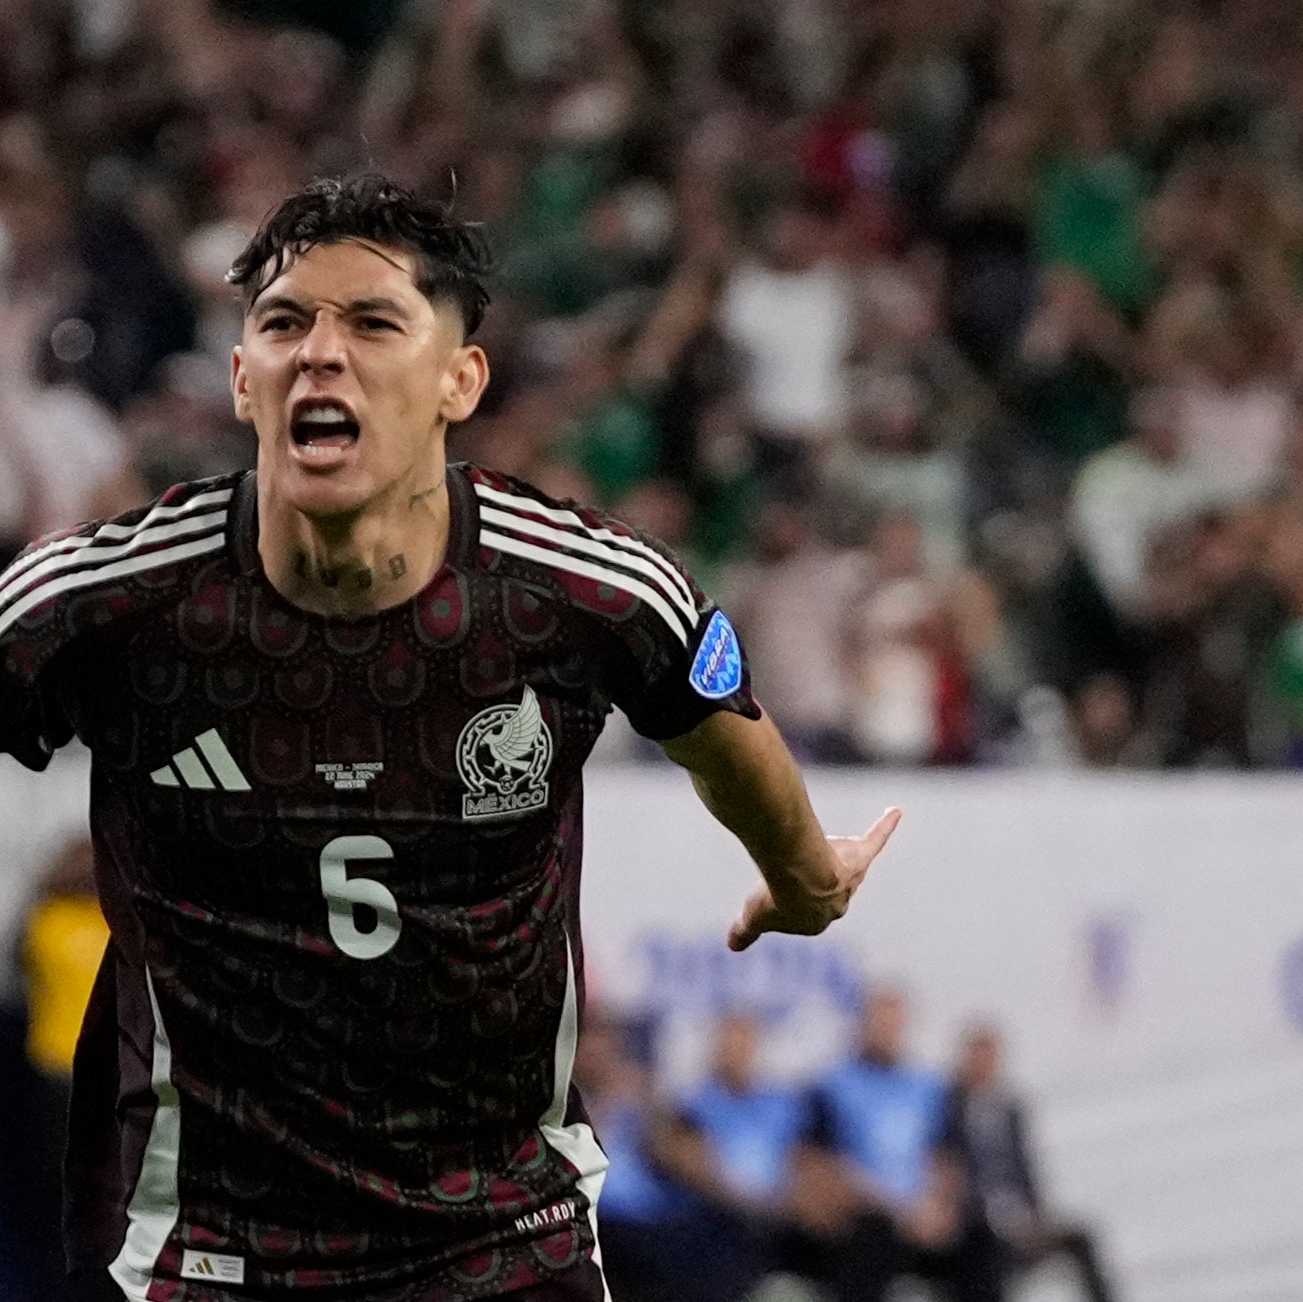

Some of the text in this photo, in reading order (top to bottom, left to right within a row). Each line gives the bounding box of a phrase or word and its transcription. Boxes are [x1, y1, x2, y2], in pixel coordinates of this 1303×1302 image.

[466, 789, 545, 814] MÉXICO
[320, 835, 402, 960] 6
[514, 1201, 576, 1231] HEAT.RDY
